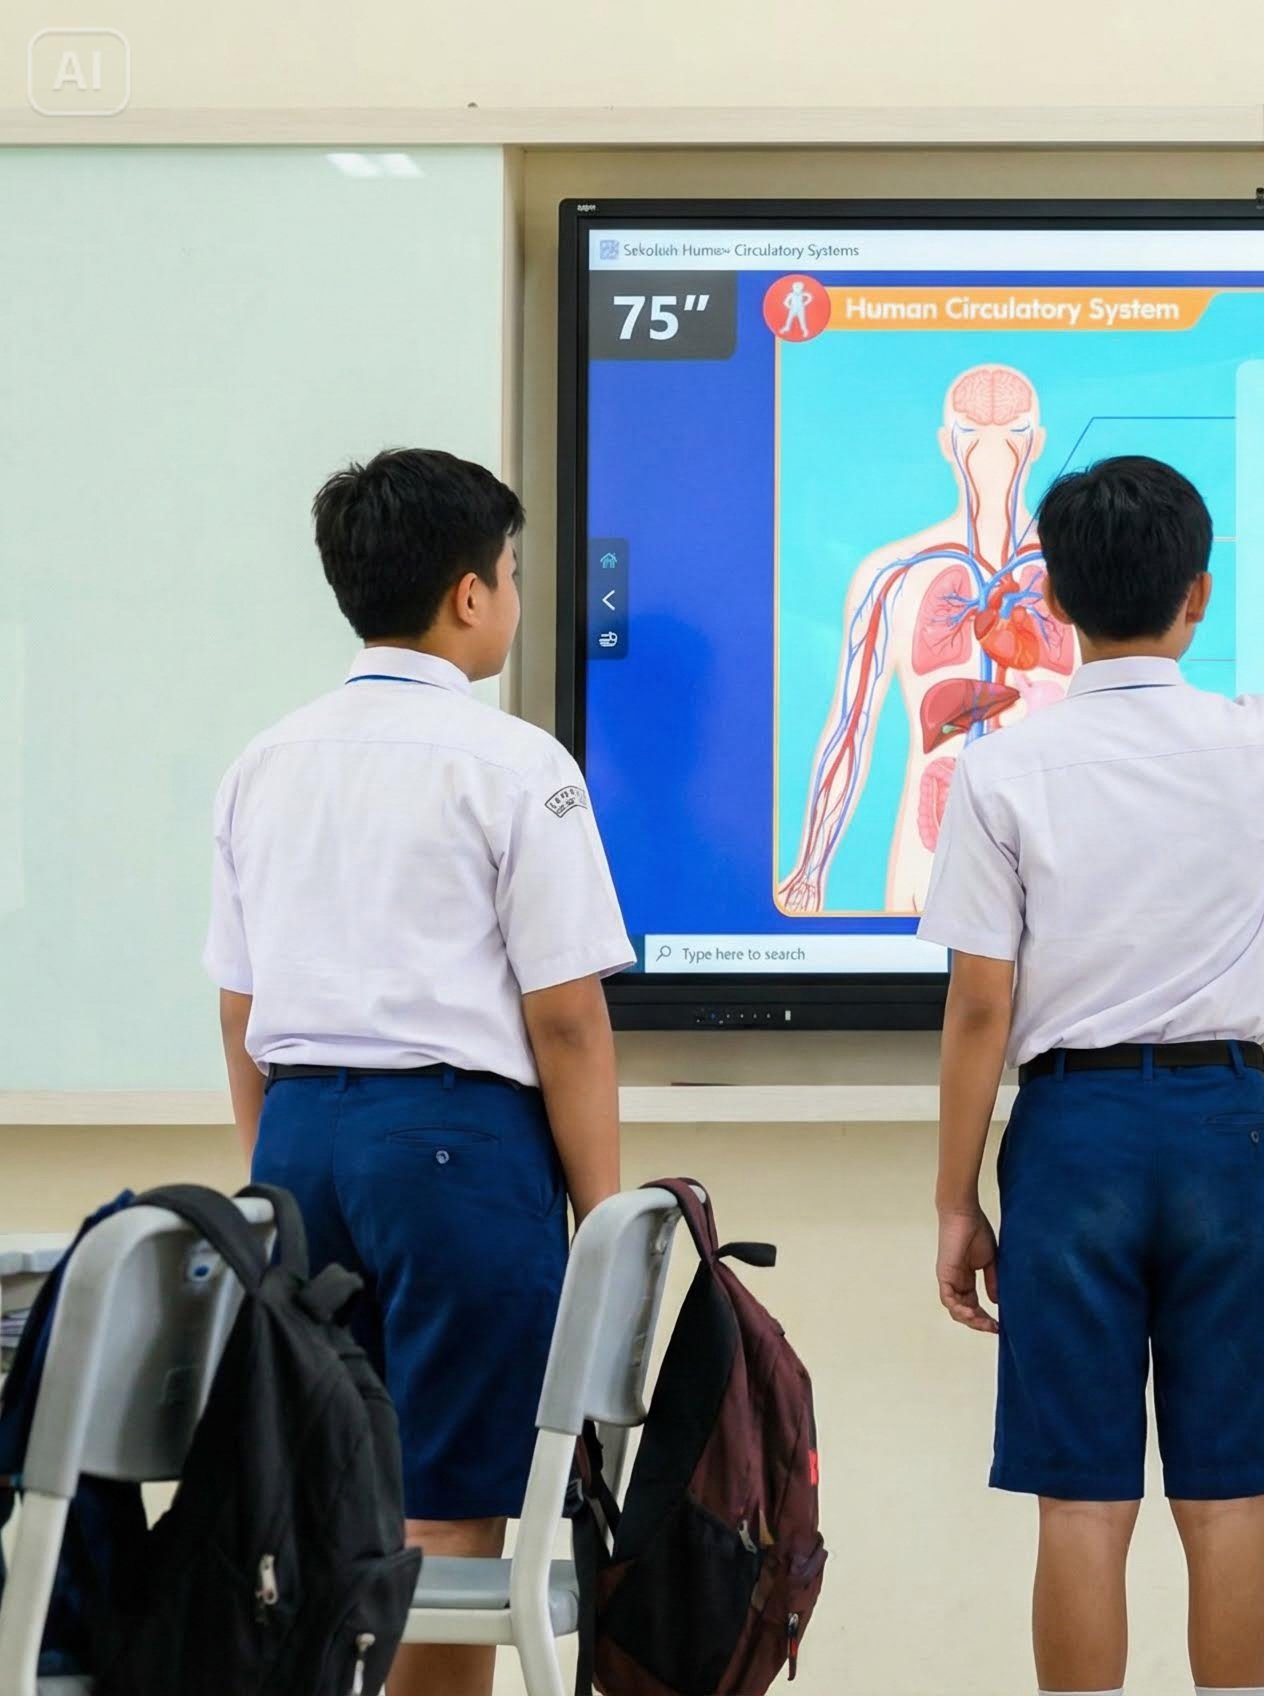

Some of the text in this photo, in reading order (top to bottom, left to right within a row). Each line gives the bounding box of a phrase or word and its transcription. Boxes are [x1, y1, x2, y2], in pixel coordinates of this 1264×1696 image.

[734, 243, 804, 260] Circulatory
[807, 243, 860, 260] Systems
[845, 296, 1180, 326] Human Circulatory System
[682, 947, 806, 964] Type here to search
